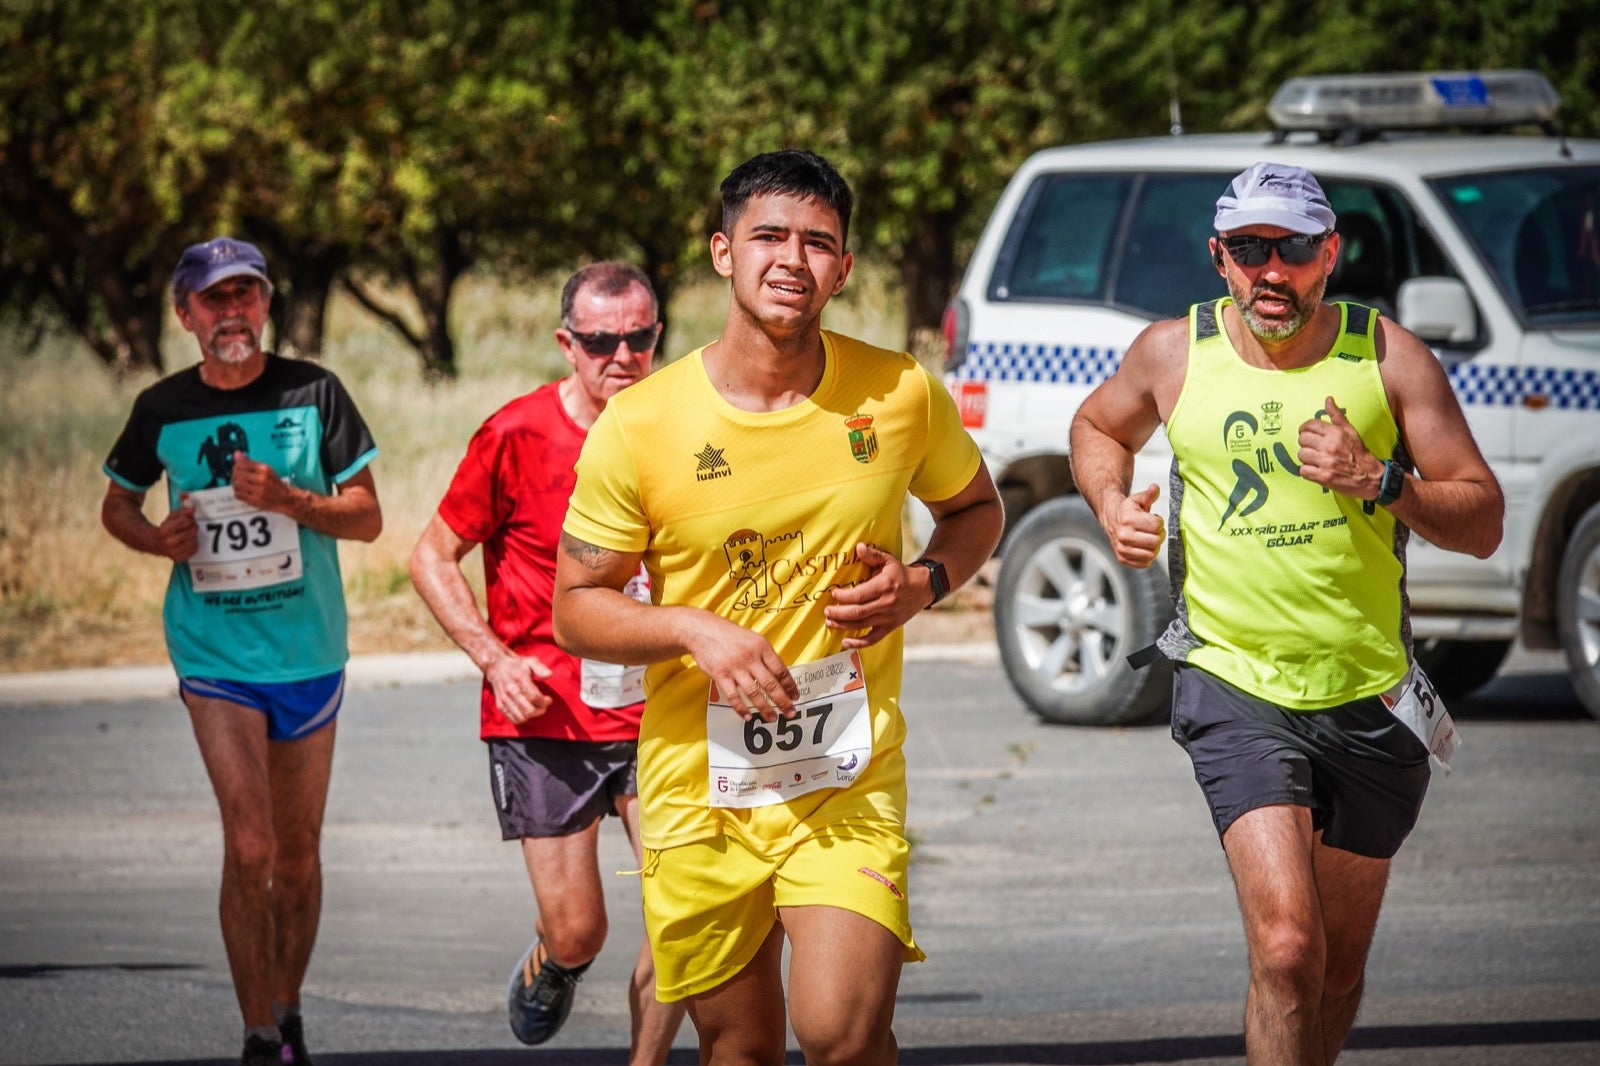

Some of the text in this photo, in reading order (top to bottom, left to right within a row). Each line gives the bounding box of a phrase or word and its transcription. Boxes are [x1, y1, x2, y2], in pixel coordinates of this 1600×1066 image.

[696, 467, 732, 481] luanvi
[206, 515, 272, 553] 793
[1230, 527, 1253, 537] XXX
[1266, 534, 1314, 548] GÓJAR
[769, 542, 876, 586] CASTILL
[826, 661, 845, 678] 2022
[743, 703, 833, 755] 657
